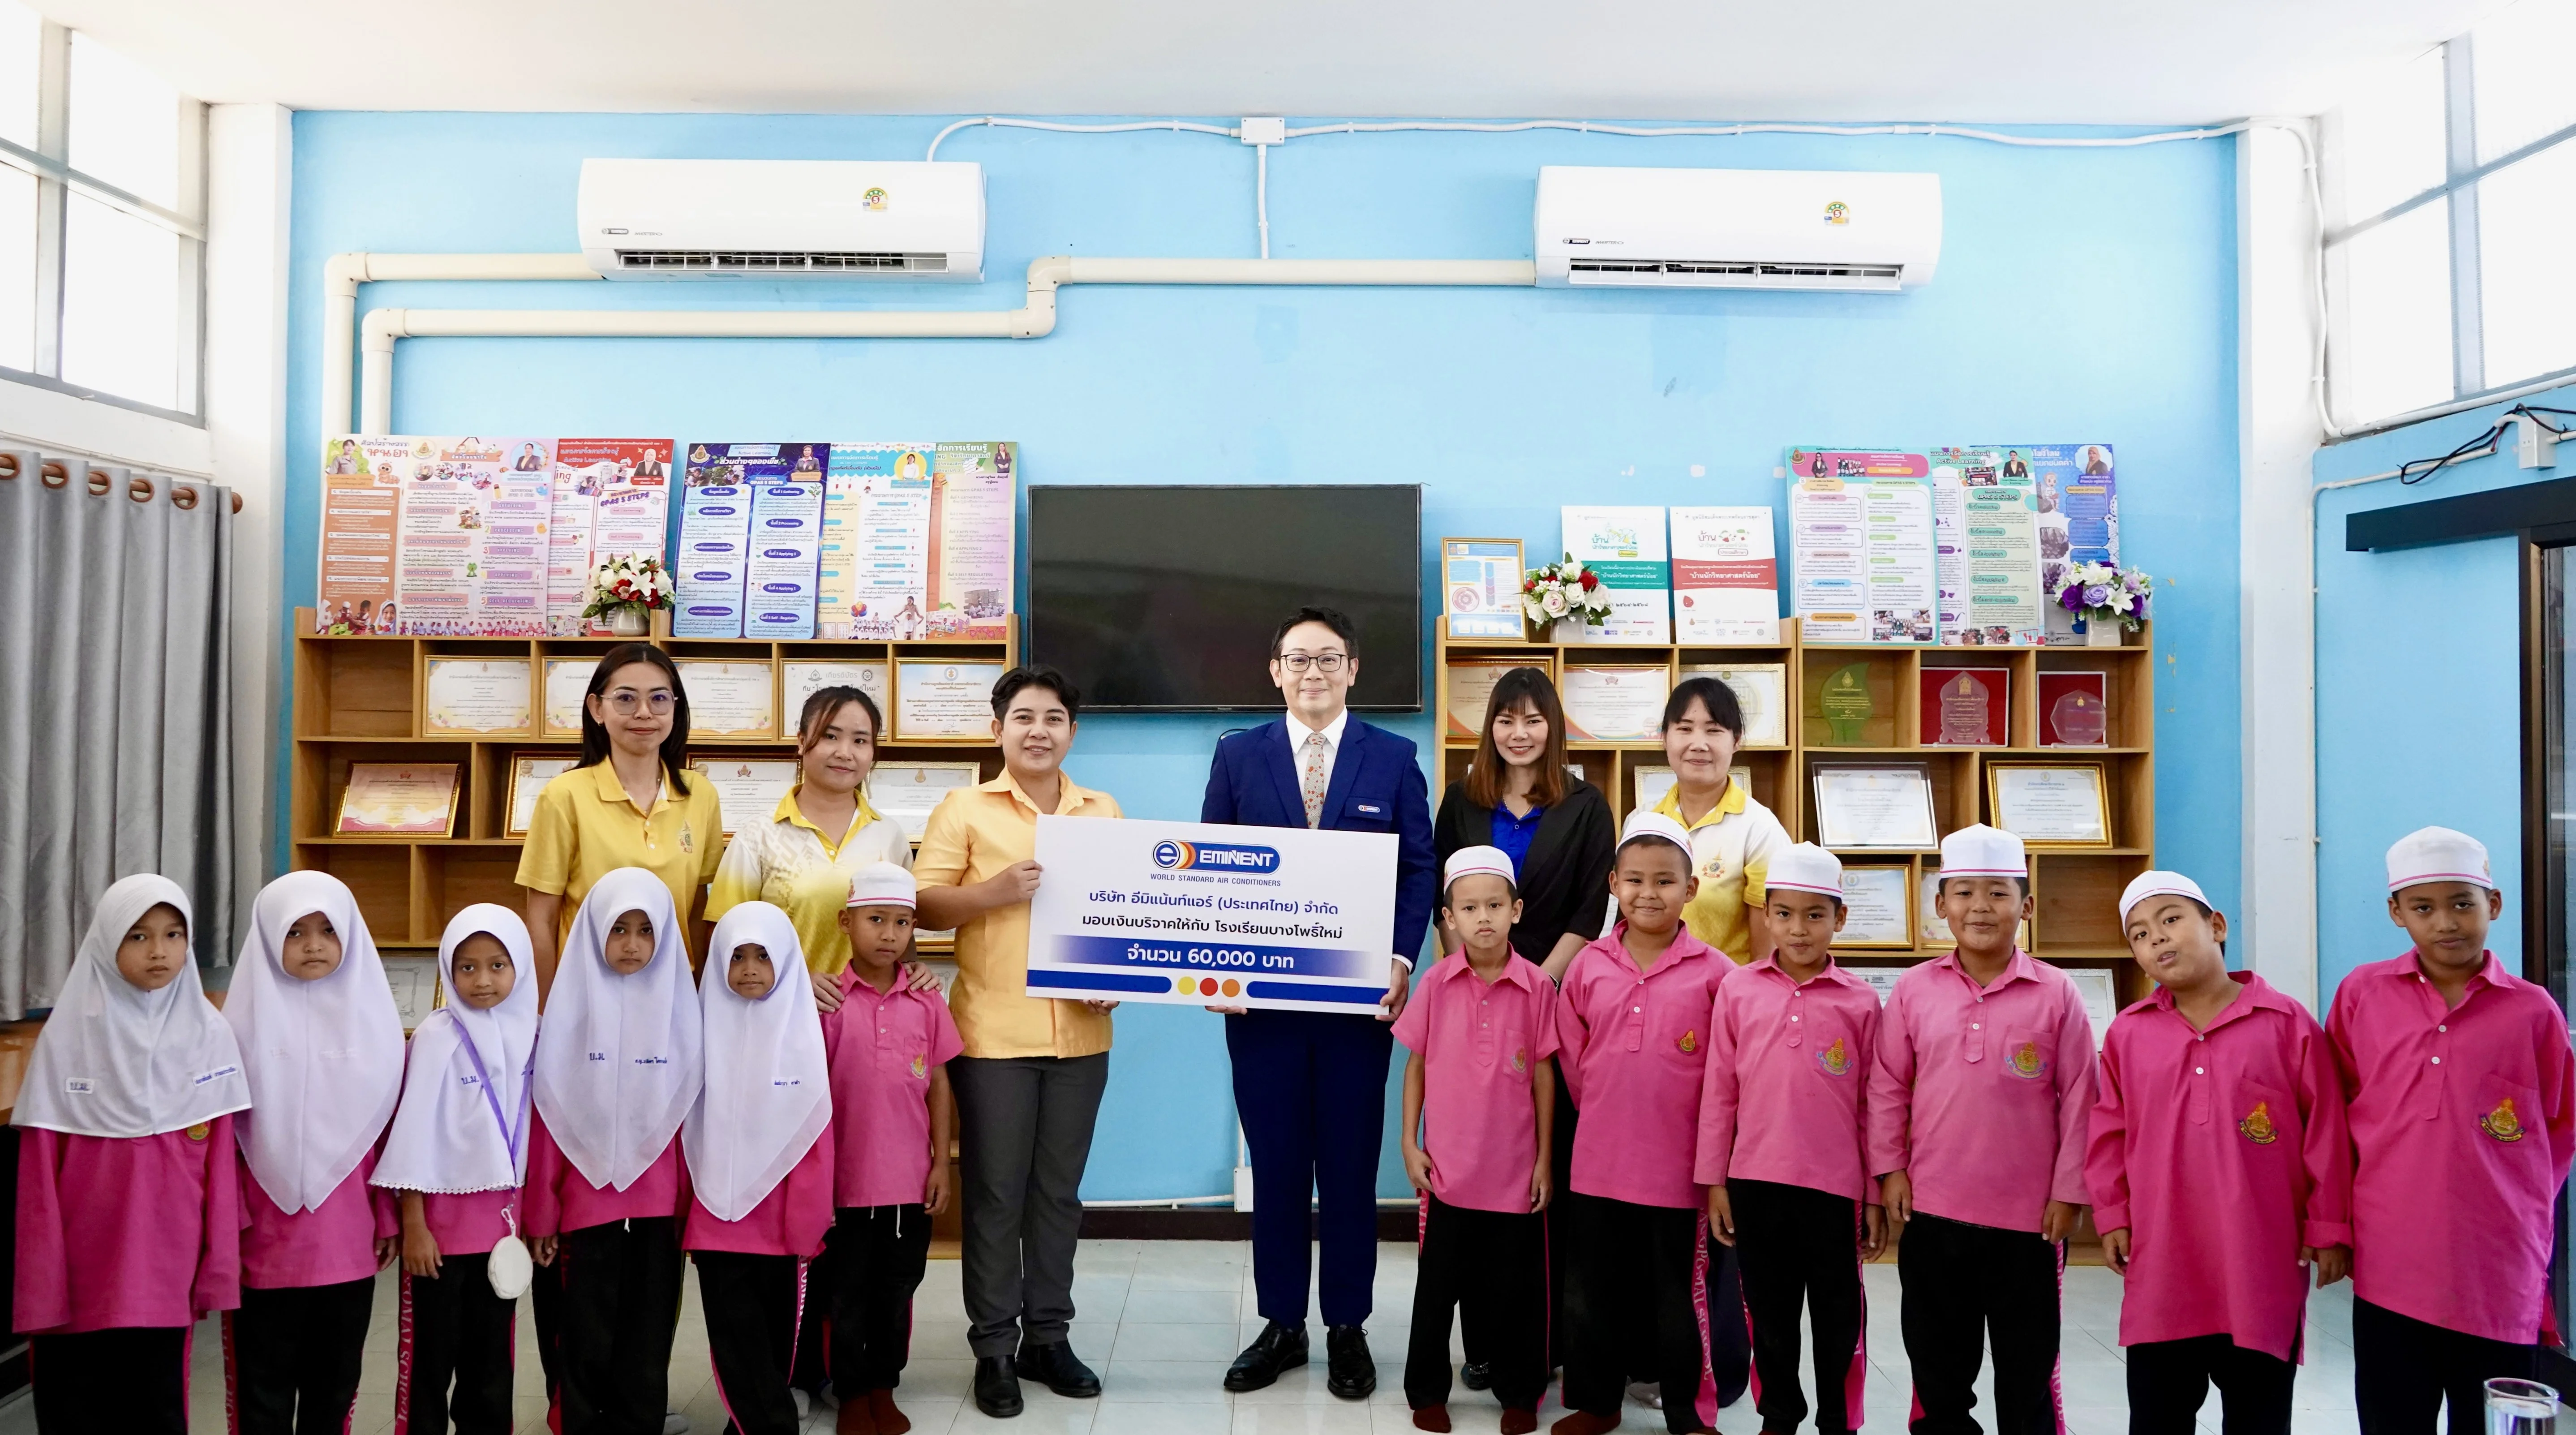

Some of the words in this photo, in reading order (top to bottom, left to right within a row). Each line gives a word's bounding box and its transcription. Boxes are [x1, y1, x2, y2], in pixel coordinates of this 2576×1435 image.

[1592, 533, 1609, 544] บ้าน
[1697, 530, 1717, 541] บ้าน
[1199, 849, 1274, 867] EMINENT
[1150, 873, 1176, 881] WORLD
[1178, 874, 1215, 883] STANDARD
[1232, 877, 1281, 887] CONDITIONERS
[1089, 890, 1126, 903] บริษัท
[1131, 891, 1213, 908] อีมิแน้นท์แอร์
[1217, 897, 1299, 915] (ประเทศไทย)
[1304, 900, 1339, 915] จำกัด
[1082, 914, 1210, 932] มอบเงินบริจาคให้กับ
[1215, 920, 1343, 939] โรงเรียนบางโพธิ์ใหม่
[1127, 943, 1181, 963] จำนวน
[1187, 947, 1256, 968] 60,000
[1262, 954, 1294, 969] บาท
